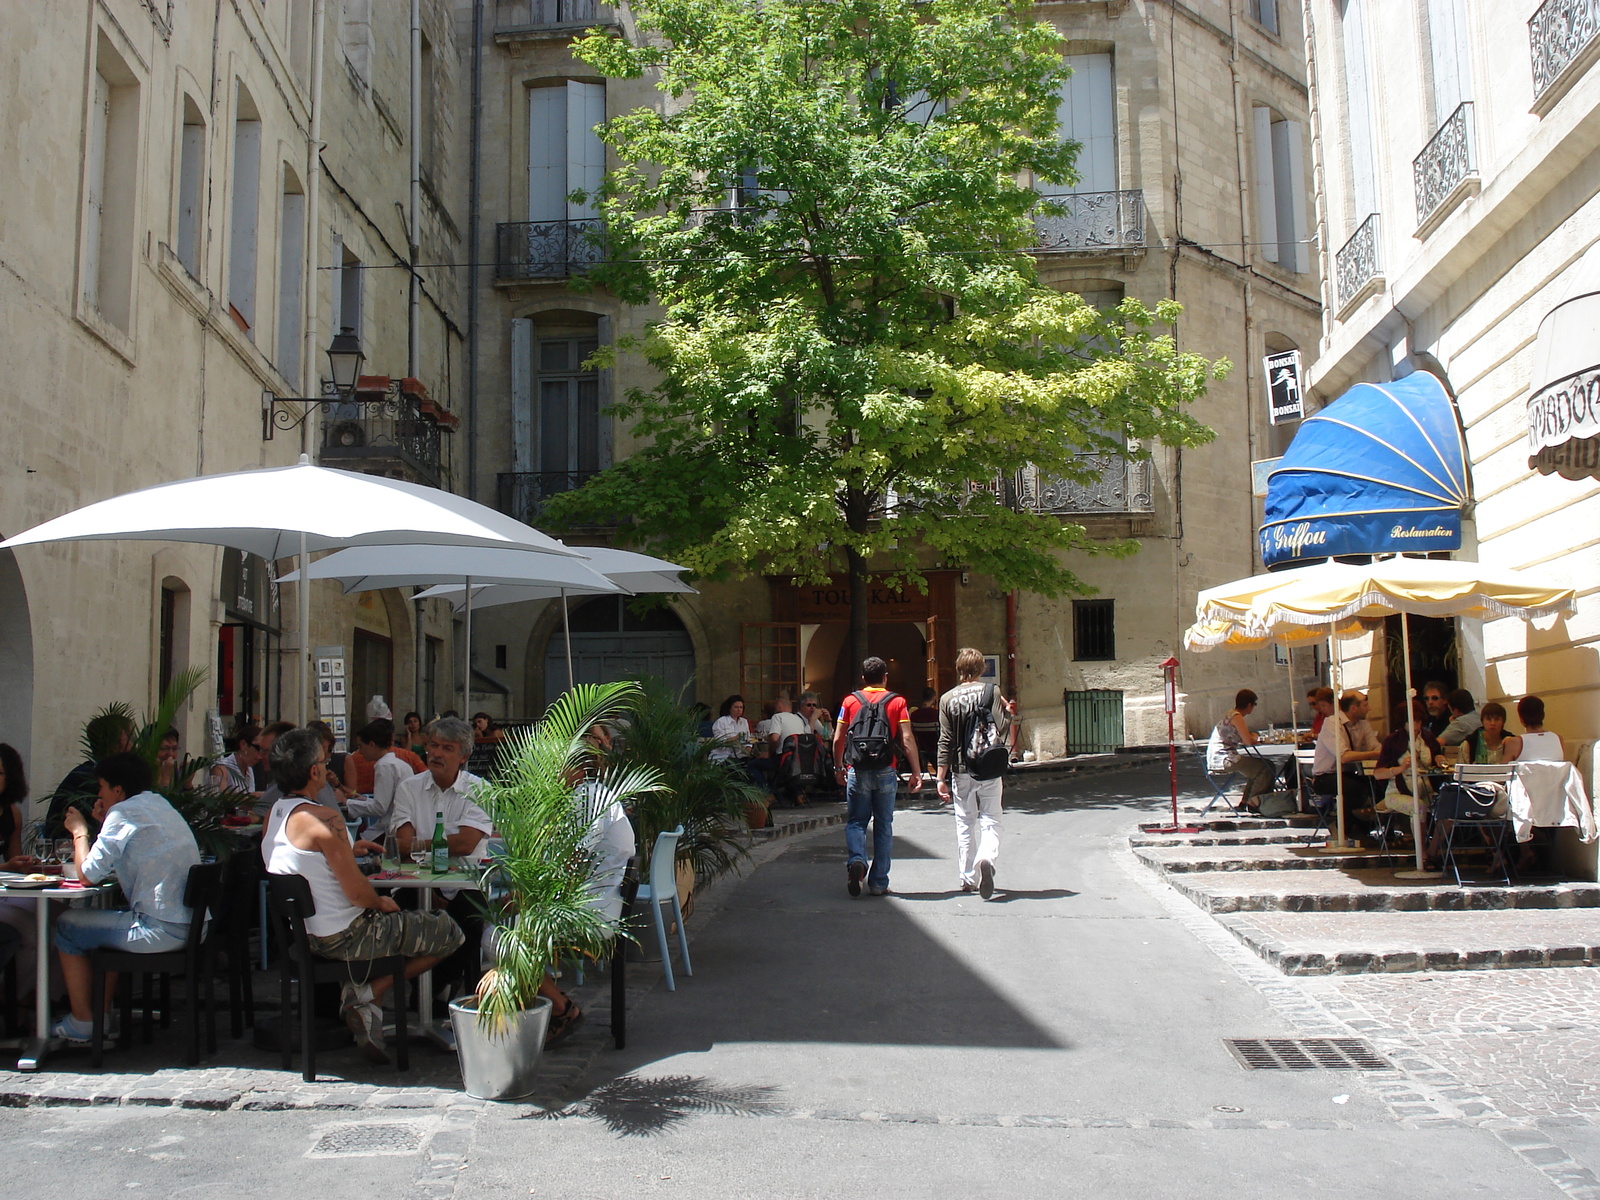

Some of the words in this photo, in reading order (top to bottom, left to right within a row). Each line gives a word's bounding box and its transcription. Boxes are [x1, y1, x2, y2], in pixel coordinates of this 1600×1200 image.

[1273, 522, 1326, 557] Griffou
[1390, 525, 1453, 538] Restauration
[812, 587, 911, 606] TOUKAL
